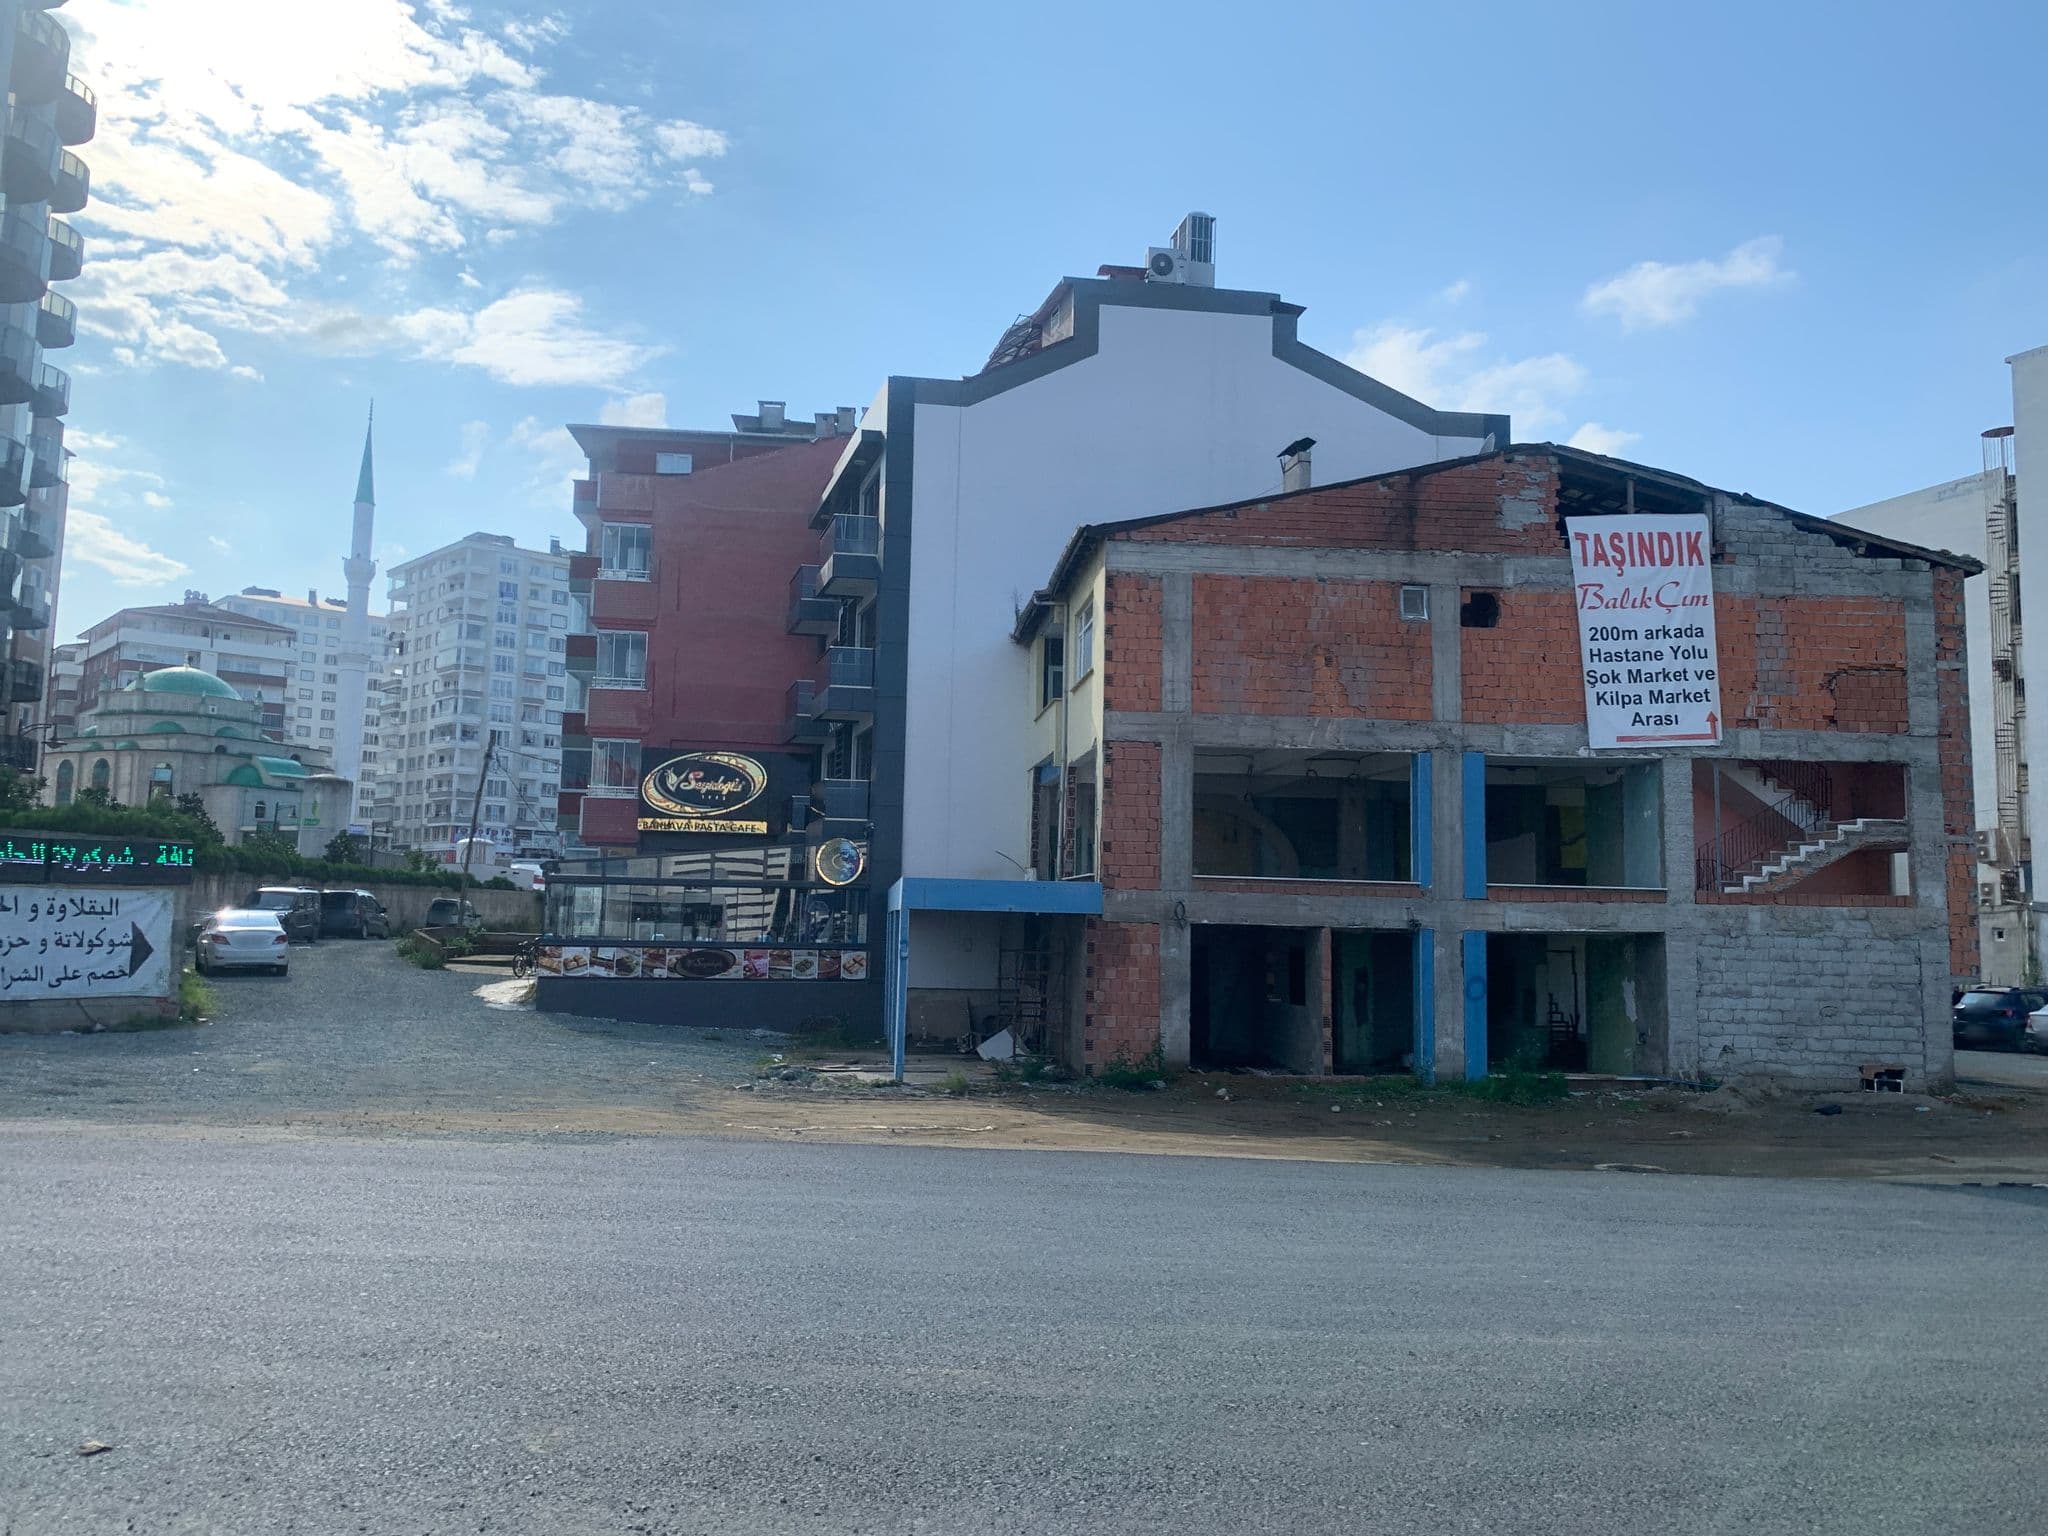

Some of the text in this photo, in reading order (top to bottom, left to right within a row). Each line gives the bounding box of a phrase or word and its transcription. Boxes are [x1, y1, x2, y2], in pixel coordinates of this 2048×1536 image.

[1574, 531, 1704, 577] TAŞINDIK
[1577, 581, 1652, 610] Balık
[1588, 624, 1704, 642] 200m arkada
[1589, 646, 1708, 663] Hastane Yolu
[1586, 668, 1715, 688] Şok Market ve
[1596, 689, 1711, 709] Kilpa Market
[1631, 712, 1679, 727] Arası
[694, 822, 727, 832] PASTA
[729, 823, 757, 833] CAFE
[28, 904, 39, 922] و
[47, 897, 119, 922] البقلاوة
[38, 939, 48, 955] و
[54, 927, 133, 955] شوكولاتة
[48, 965, 82, 988] على
[87, 965, 129, 987] خصم
